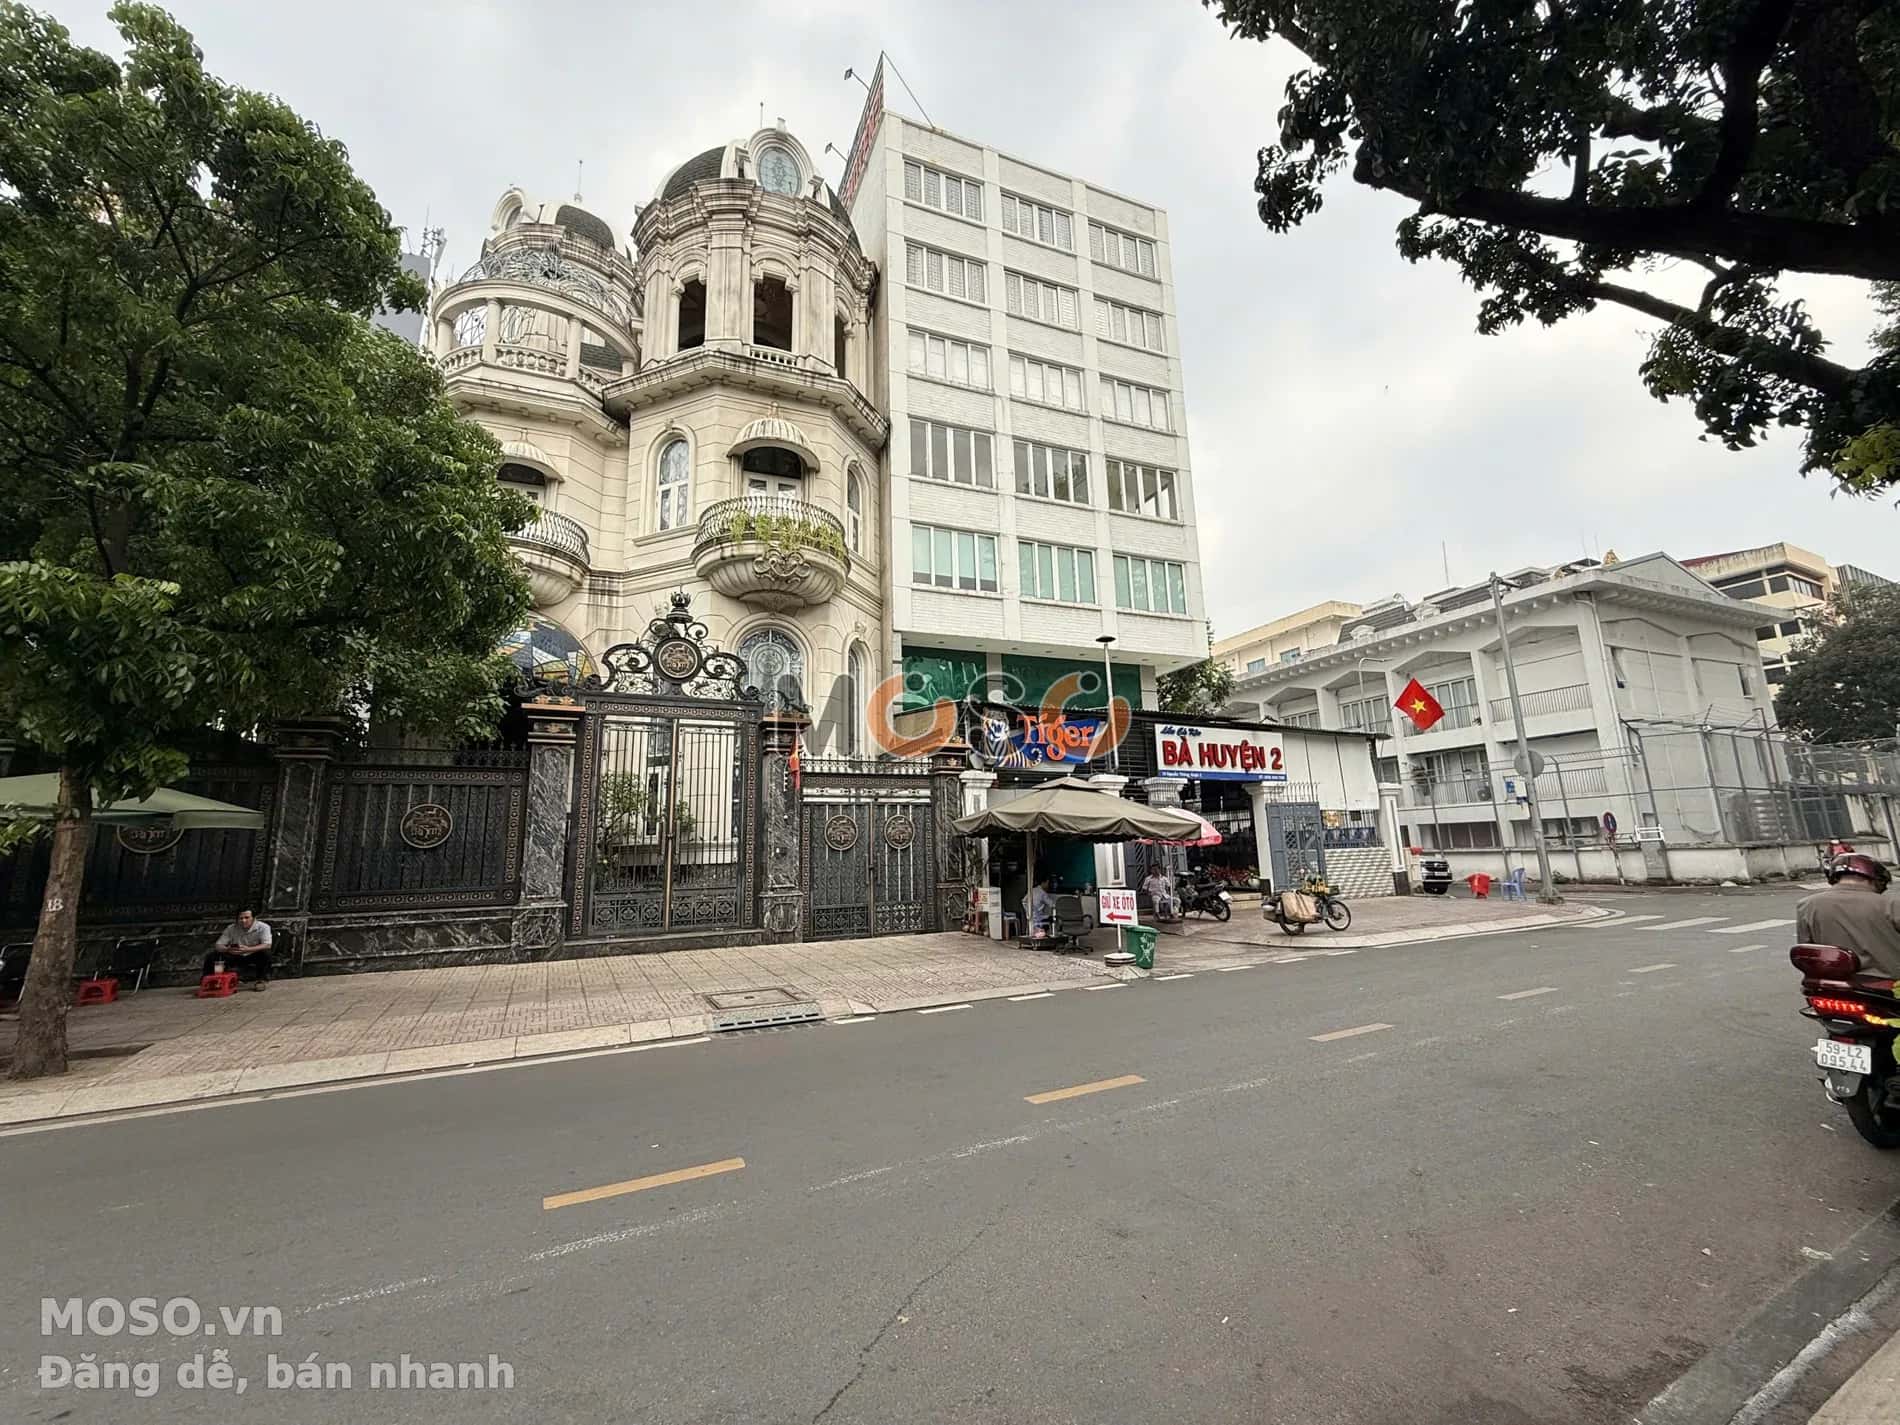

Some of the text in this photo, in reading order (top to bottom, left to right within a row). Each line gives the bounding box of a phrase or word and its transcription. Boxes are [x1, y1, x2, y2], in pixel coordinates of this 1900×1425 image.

[1016, 713, 1094, 760] Tiger
[1162, 736, 1283, 772] BÀ HUYỆN 2
[1112, 896, 1121, 910] XE
[1826, 1043, 1863, 1059] 59-L2
